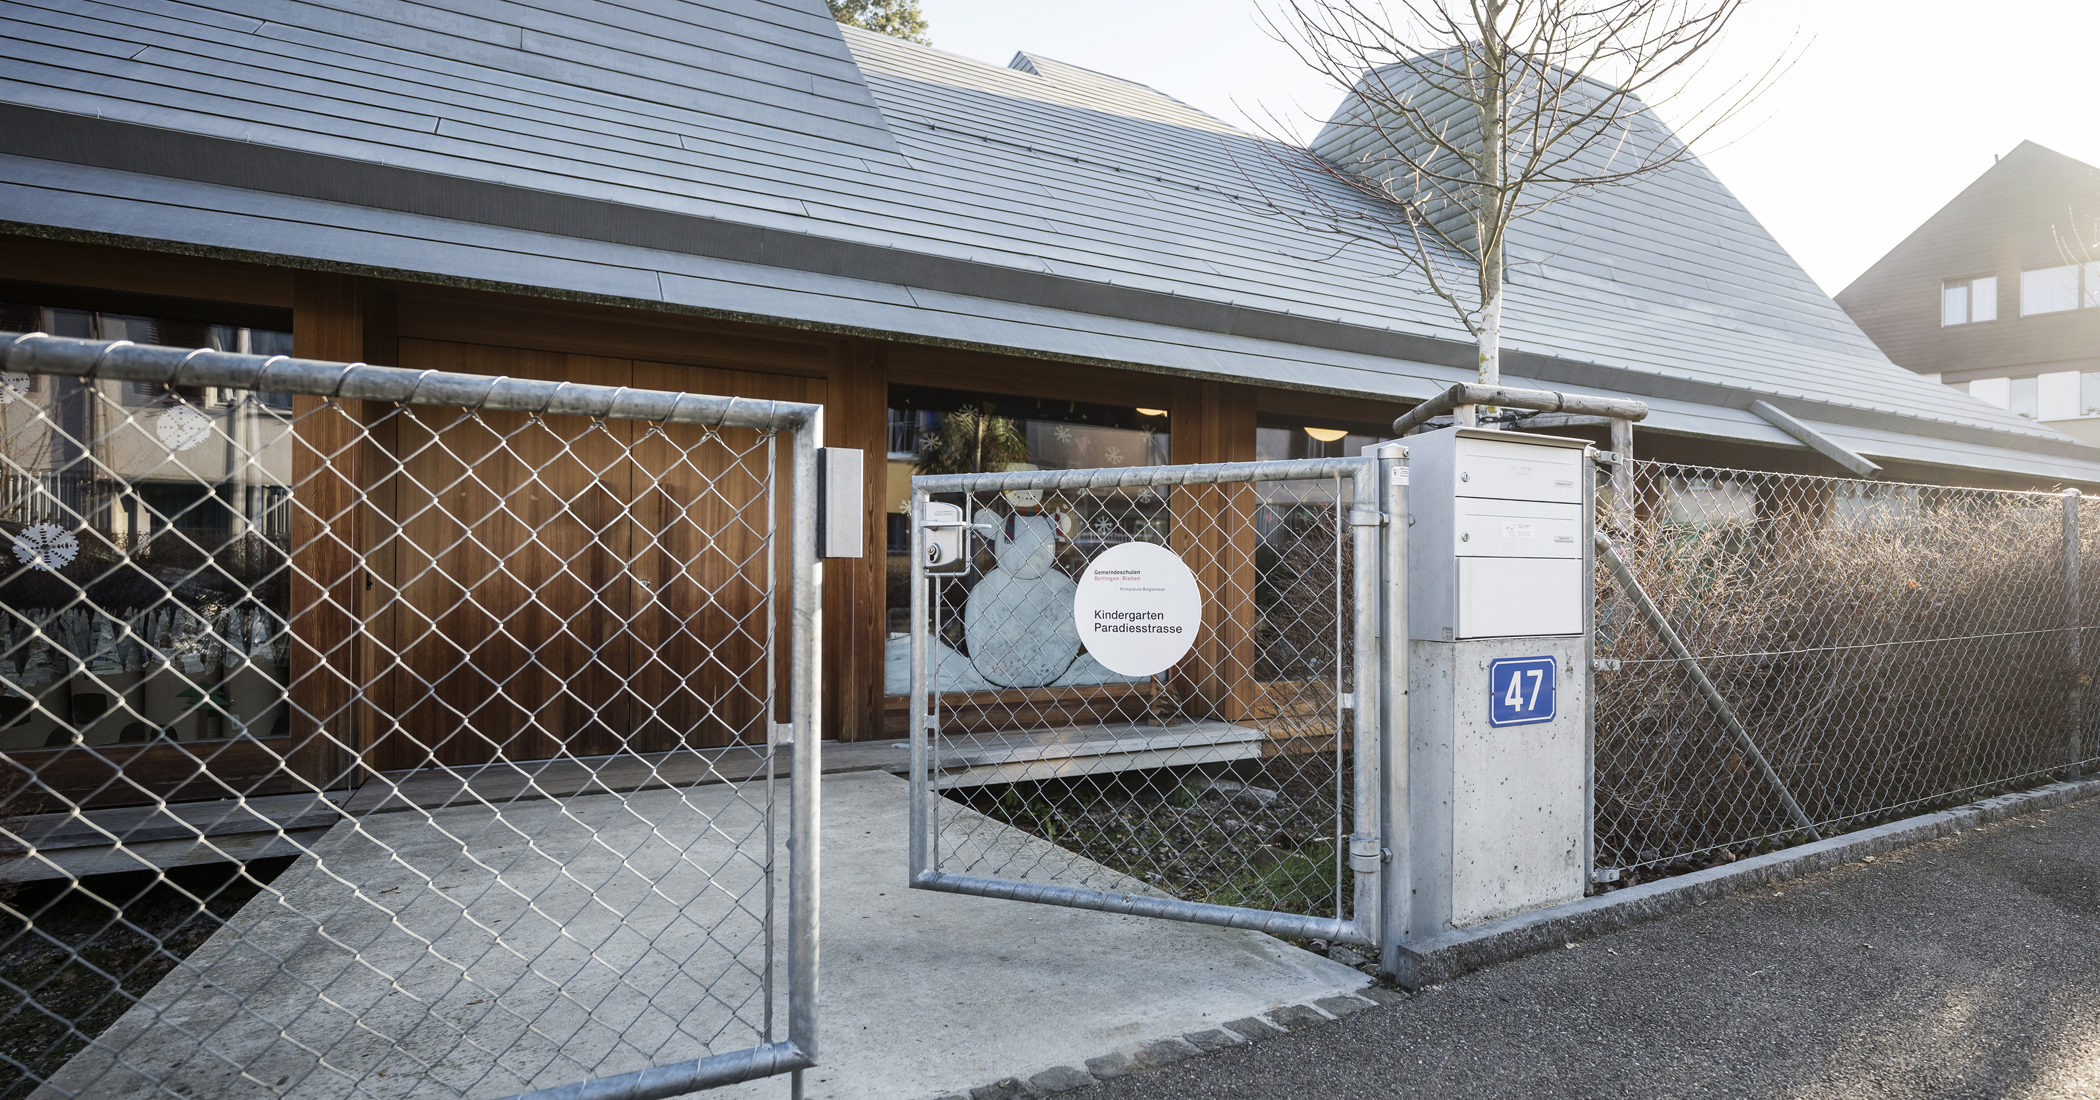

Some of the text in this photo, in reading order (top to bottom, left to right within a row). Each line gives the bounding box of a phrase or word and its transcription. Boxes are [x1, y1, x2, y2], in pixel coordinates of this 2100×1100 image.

[1094, 610, 1164, 622] Kindergarten
[1094, 622, 1183, 634] Paradiesstrasse
[1504, 669, 1544, 712] 47
